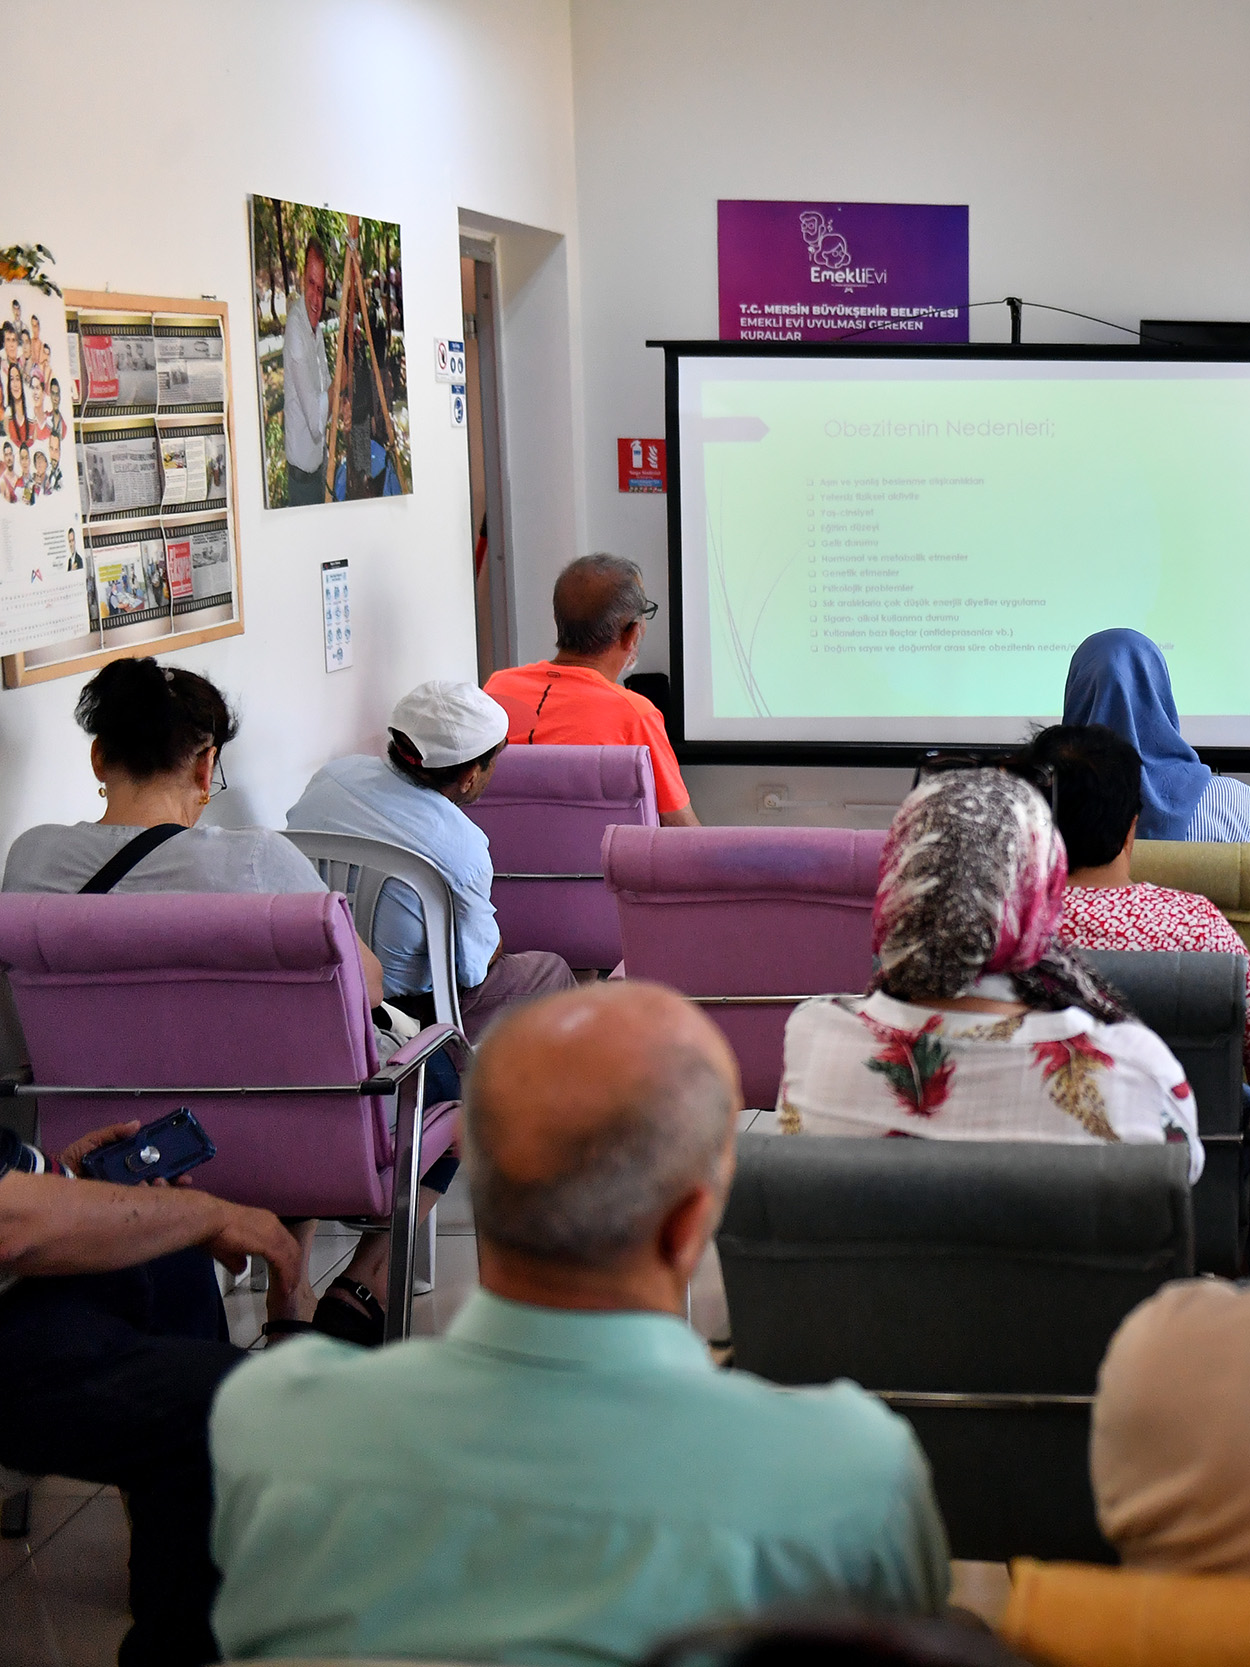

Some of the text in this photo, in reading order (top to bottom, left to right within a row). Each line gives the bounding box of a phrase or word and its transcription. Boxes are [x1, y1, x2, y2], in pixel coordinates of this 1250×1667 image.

[810, 266, 887, 284] EmekliEvi
[739, 304, 762, 314] T.C.
[764, 303, 810, 315] MERSİN
[812, 304, 888, 318] BÜYÜKŞEHİR
[740, 316, 924, 331] EMEKLİ EVİ UYULMASI GEREKEN
[740, 331, 802, 341] KURALLAR
[823, 417, 1056, 438] Obezitenin Nedenleri;
[821, 553, 865, 563] Hormonal
[865, 583, 914, 594] problemler
[884, 599, 901, 609] çok
[903, 598, 930, 608] düşük
[1000, 597, 1047, 608] uygulama
[857, 614, 879, 623] alkol
[881, 614, 923, 623] kullanma
[925, 613, 960, 622] durumu
[996, 627, 1014, 638] vb.)
[824, 644, 856, 654] Doğum
[898, 644, 942, 654] doğumlar
[968, 643, 986, 652] süre
[988, 643, 1035, 652] obezitenin
